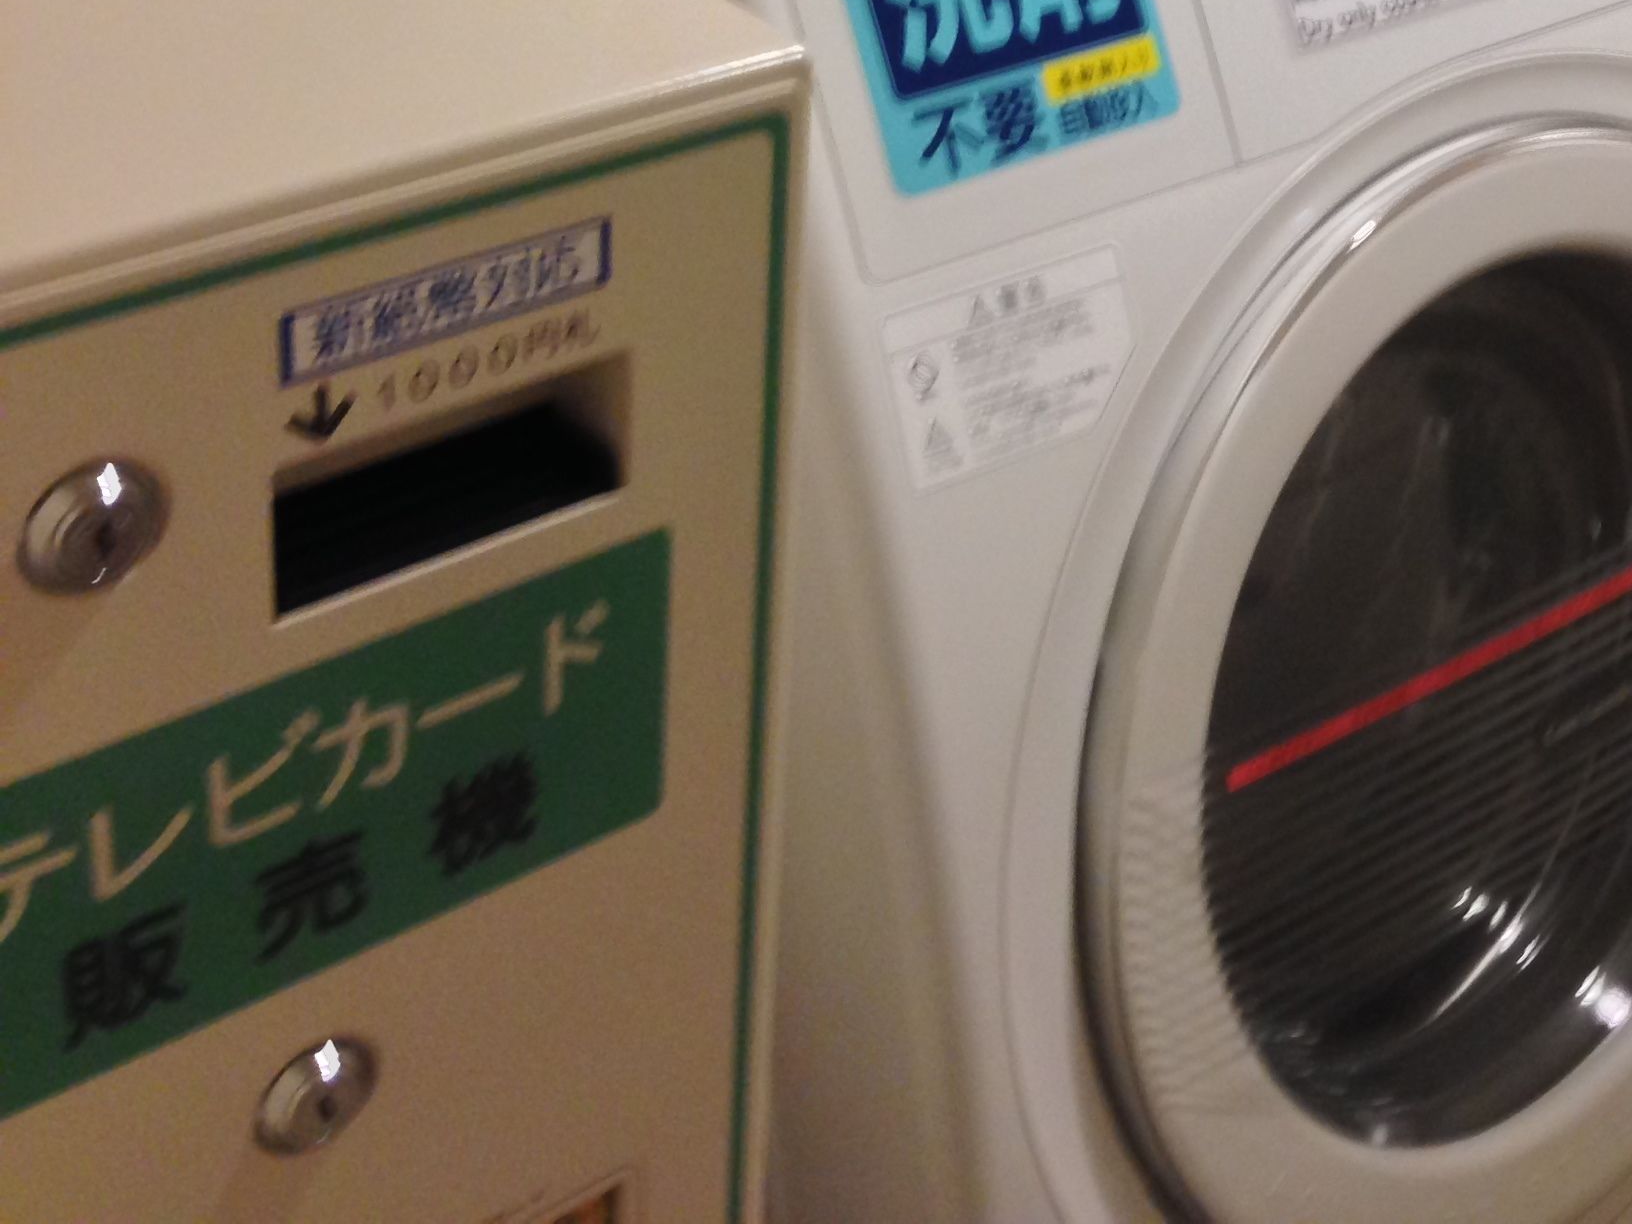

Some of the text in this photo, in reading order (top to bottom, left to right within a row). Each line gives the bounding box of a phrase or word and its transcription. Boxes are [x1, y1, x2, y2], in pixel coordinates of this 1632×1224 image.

[912, 78, 1049, 180] 不要
[0, 599, 611, 945] テレビカード
